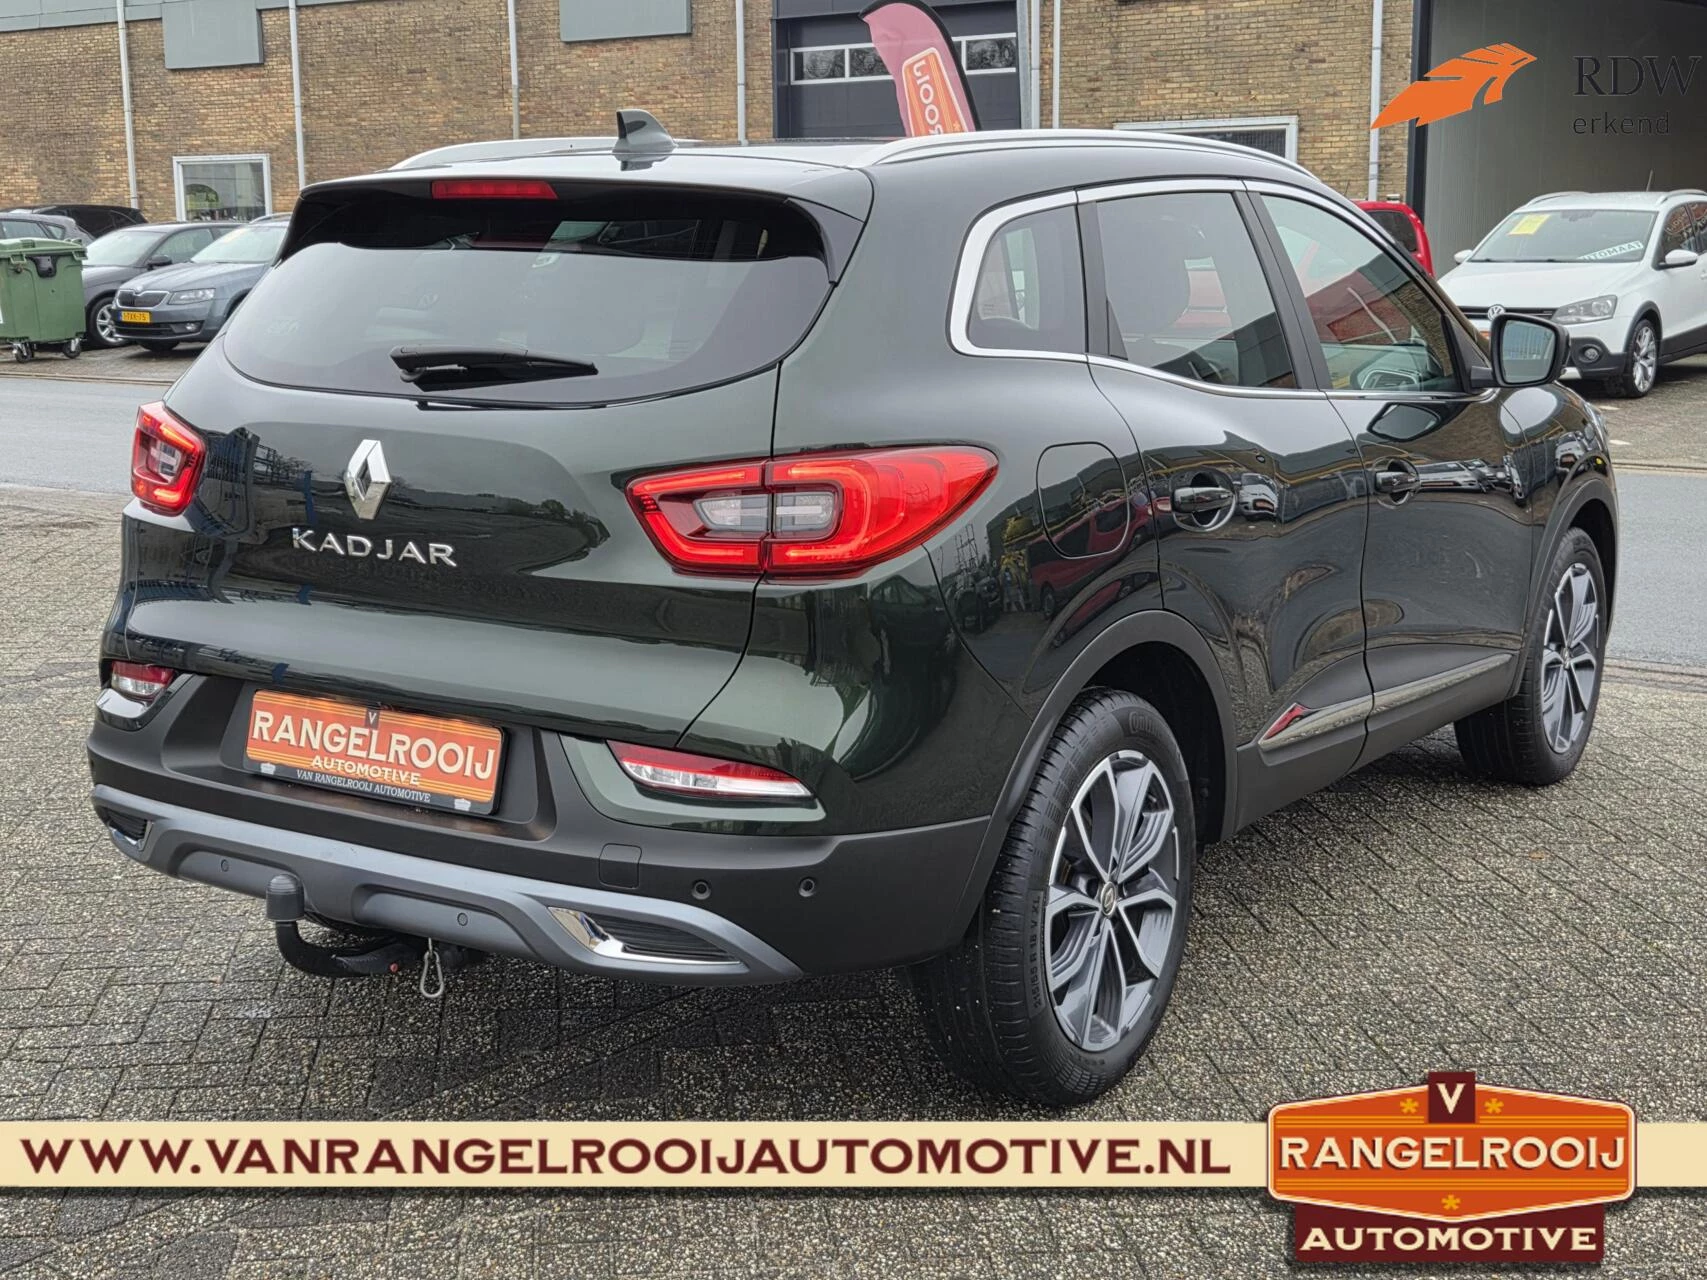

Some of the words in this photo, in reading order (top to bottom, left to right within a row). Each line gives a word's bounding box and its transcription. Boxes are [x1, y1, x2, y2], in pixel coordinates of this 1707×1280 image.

[292, 527, 457, 567] KADJAR
[368, 711, 377, 725] V
[252, 711, 495, 779] RANGELROOIJ
[296, 769, 313, 782] VAN
[314, 773, 373, 791] RANGELROOIJ
[374, 785, 431, 803] AUTOMOTIVE
[311, 755, 421, 786] AUTOMOTIVE
